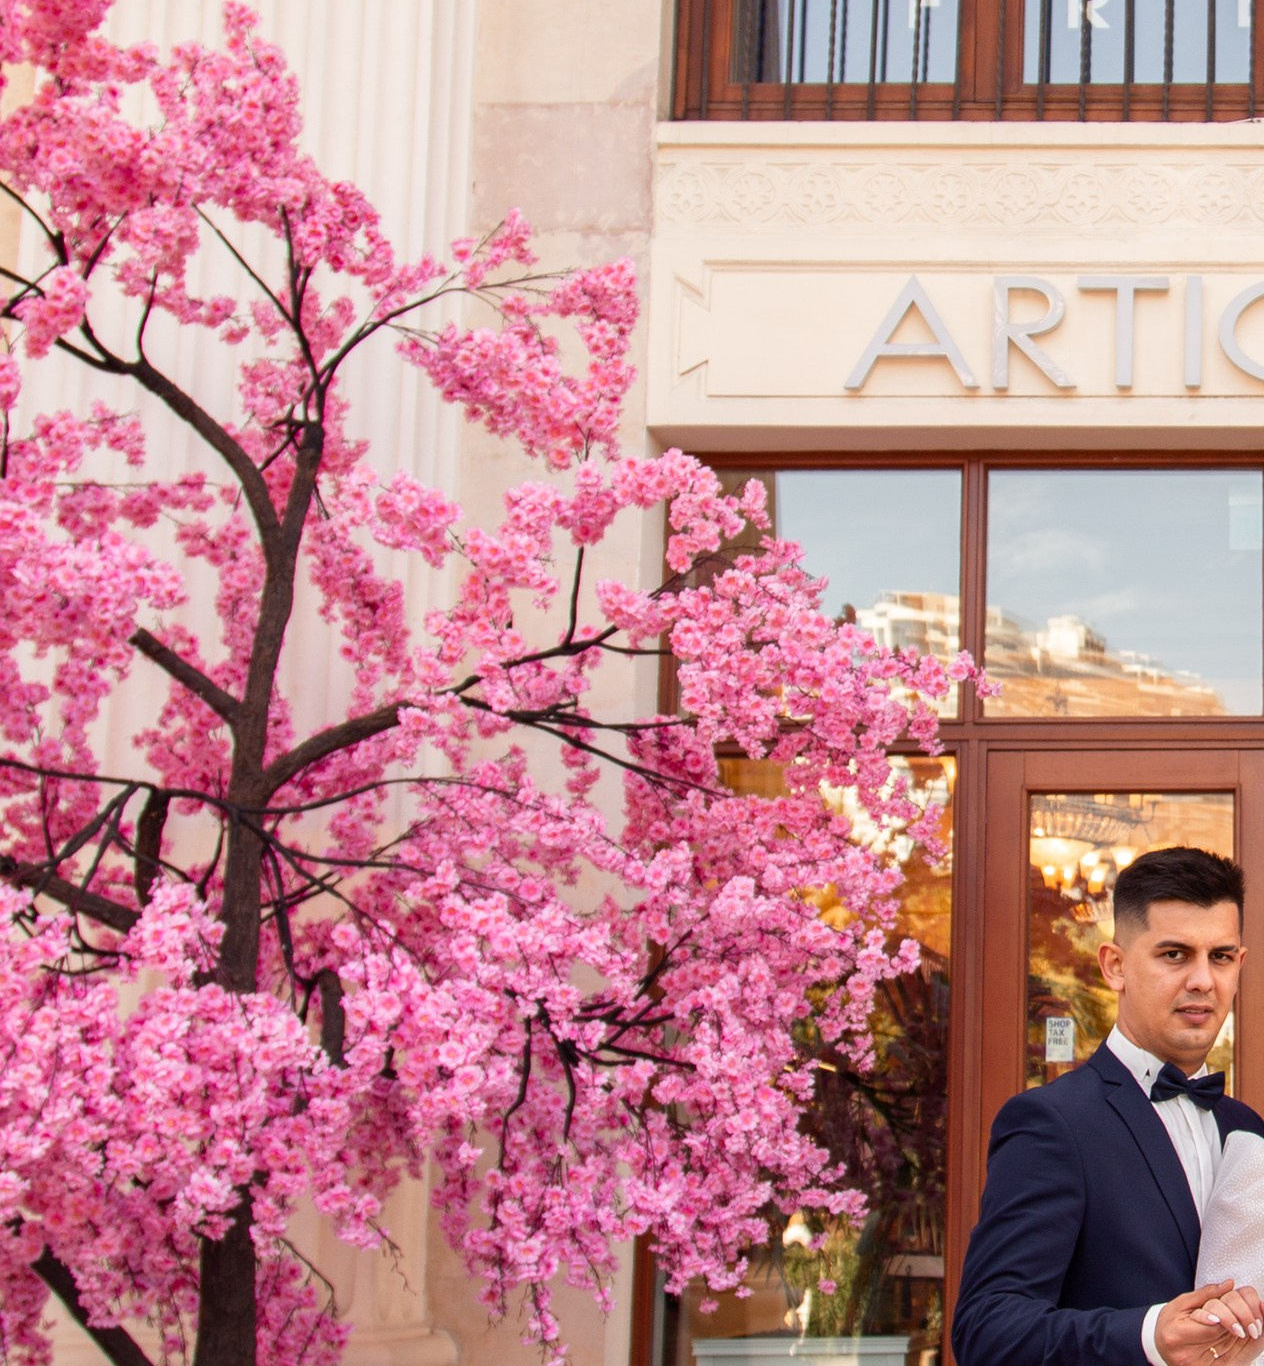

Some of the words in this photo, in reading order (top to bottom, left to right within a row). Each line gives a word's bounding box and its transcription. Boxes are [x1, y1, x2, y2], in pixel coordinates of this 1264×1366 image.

[1048, 1019, 1071, 1028] SHOP
[1049, 1028, 1065, 1037] TAX
[1048, 1037, 1069, 1046] FREE
